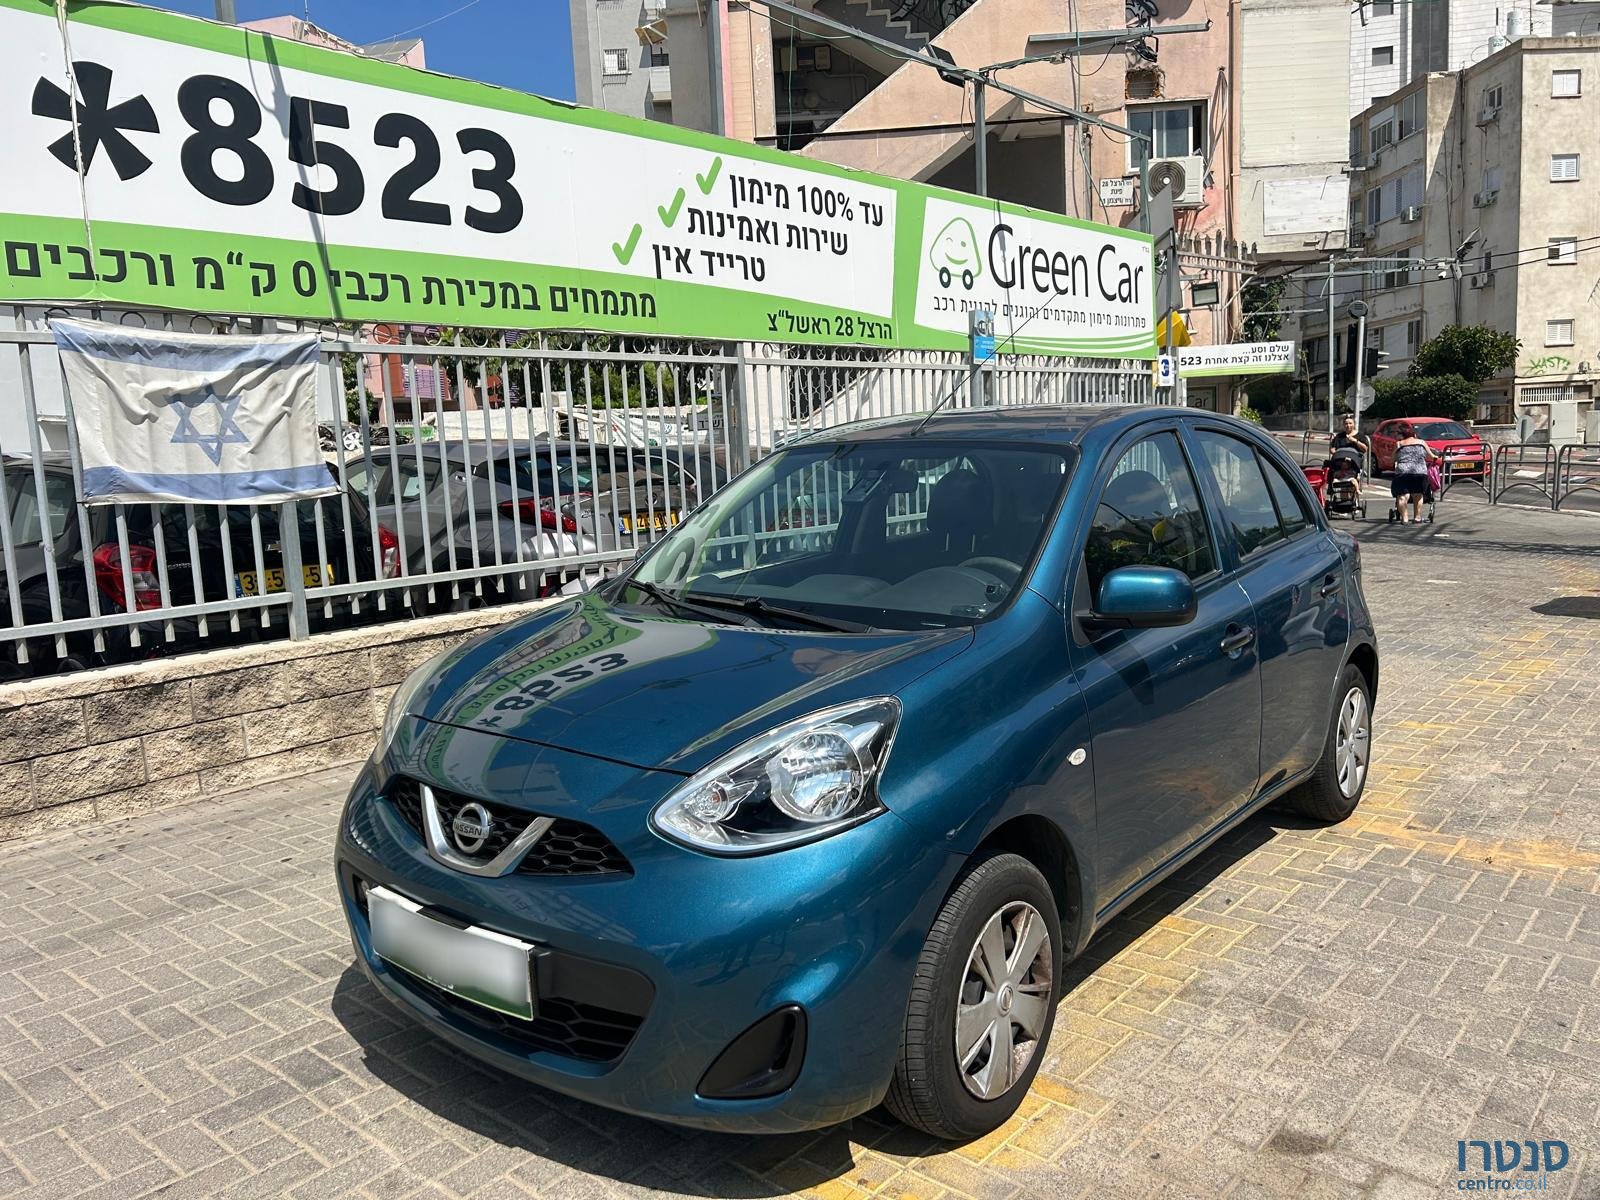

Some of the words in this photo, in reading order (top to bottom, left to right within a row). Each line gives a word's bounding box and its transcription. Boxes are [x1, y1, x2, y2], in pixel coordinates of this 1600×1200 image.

[730, 174, 790, 209] מימון
[798, 184, 854, 222] 100%
[688, 208, 779, 245] ואמינות
[858, 201, 883, 227] עד
[786, 224, 848, 256] שירות
[4, 241, 175, 287] ורכבים
[192, 251, 276, 296] ק"מ
[652, 244, 692, 279] אין
[700, 250, 766, 282] טרייד
[988, 223, 1089, 299] Green
[1097, 243, 1144, 306] Car
[292, 260, 317, 298] 0
[329, 270, 410, 304] רכבי
[422, 276, 540, 311] במכירת
[550, 286, 656, 318] מתמחים
[934, 296, 956, 312] רכב
[768, 309, 831, 336] ראשל"צ
[1003, 304, 1040, 318] והוגנים
[1044, 308, 1086, 326] מתקדמים
[1090, 312, 1112, 327] מימון
[1115, 316, 1146, 328] פתרונות
[834, 316, 854, 337] 28
[858, 316, 892, 340] הרצל
[1204, 357, 1228, 366] אחרת
[1231, 356, 1250, 365] קצת
[1252, 354, 1262, 363] זה
[1264, 352, 1290, 362] אצלנו
[1269, 344, 1290, 353] שלם
[454, 822, 482, 836] NISSAN
